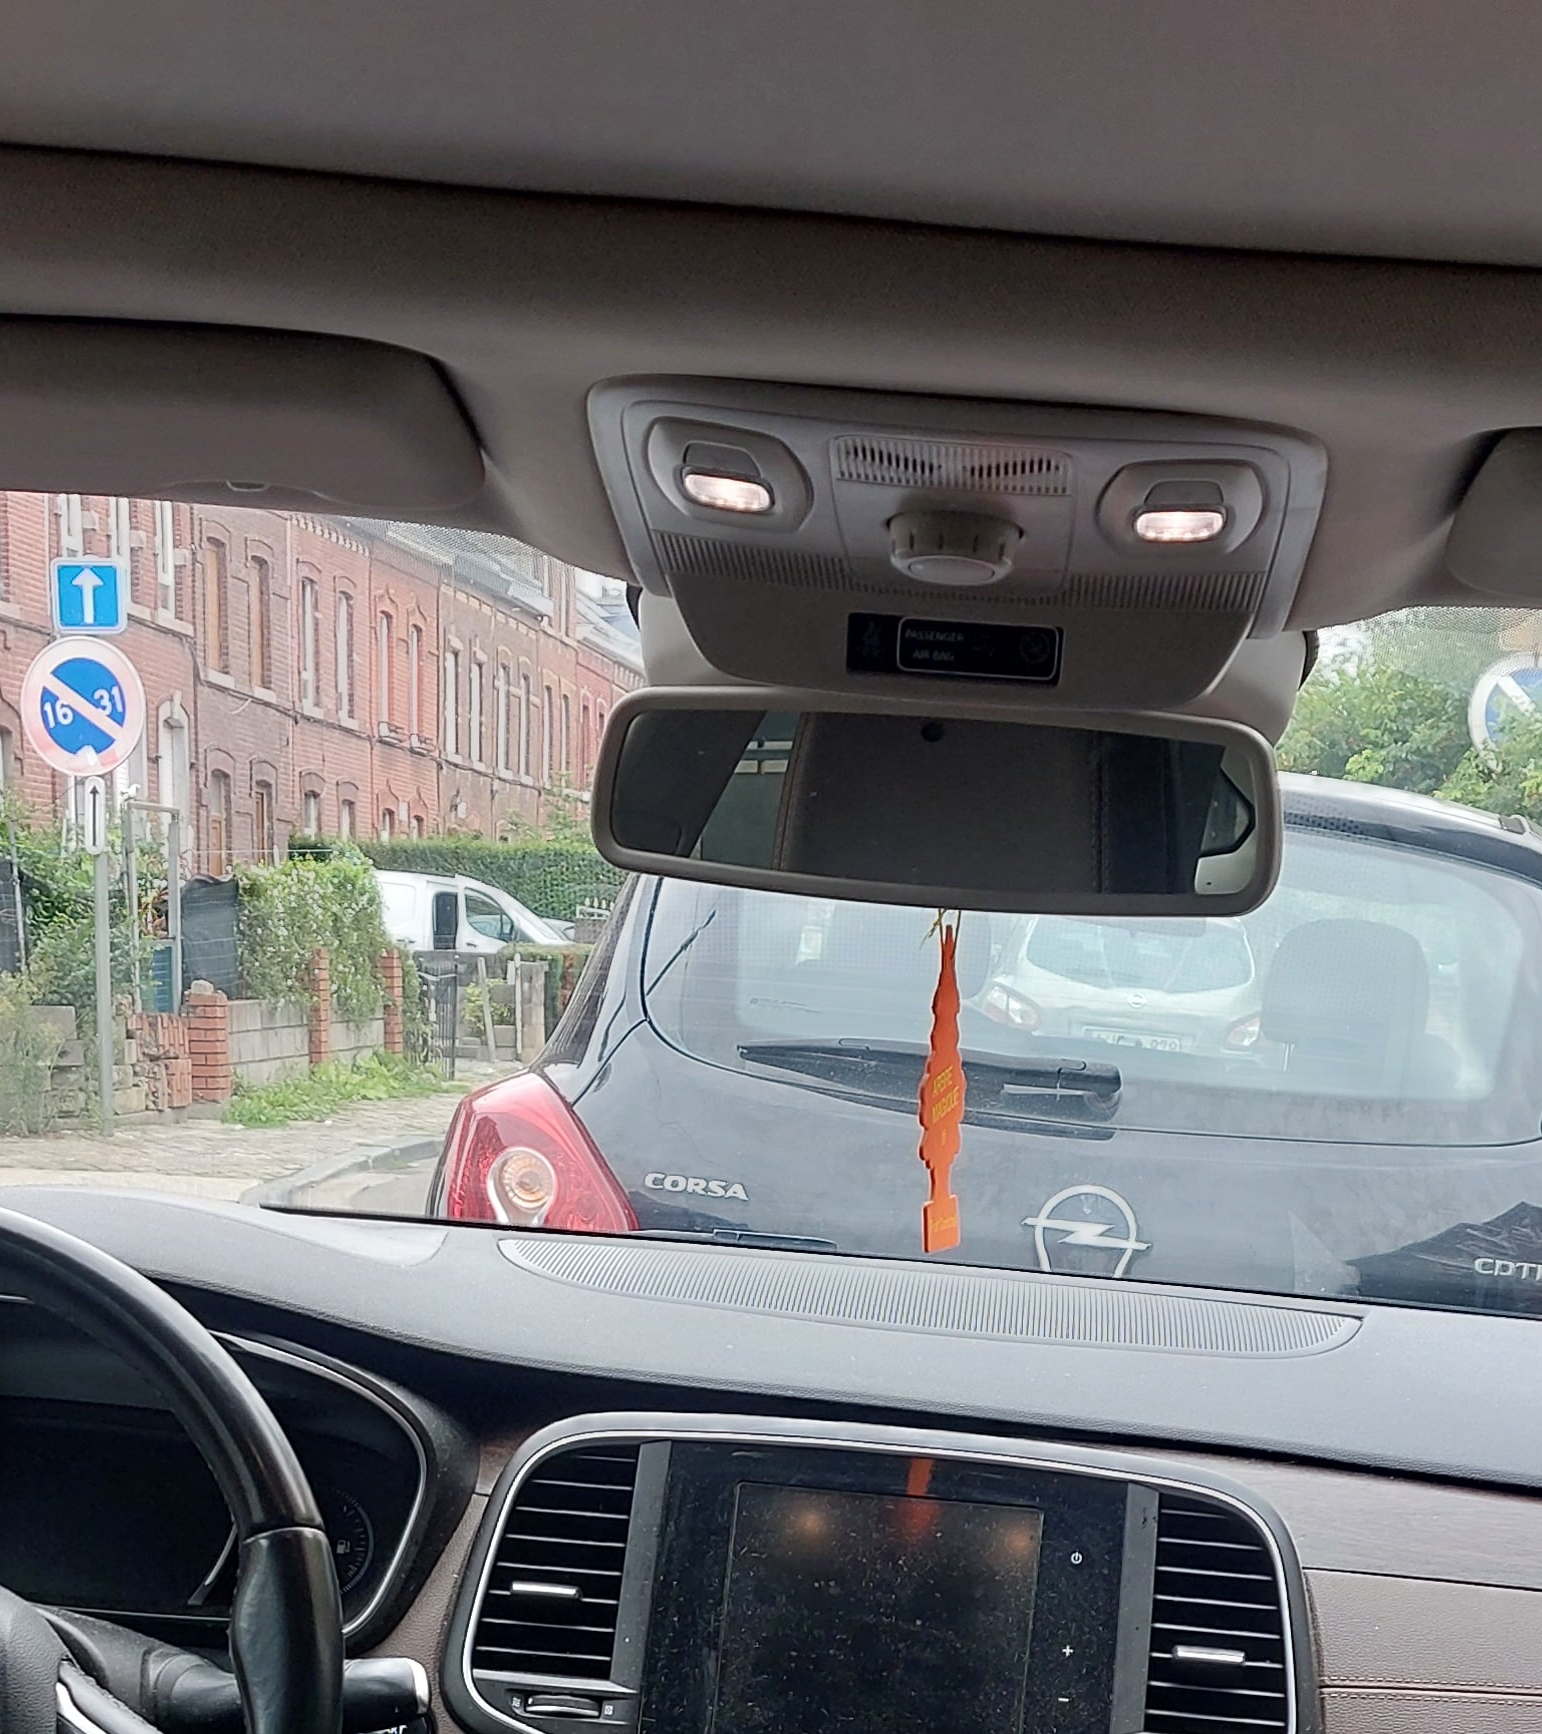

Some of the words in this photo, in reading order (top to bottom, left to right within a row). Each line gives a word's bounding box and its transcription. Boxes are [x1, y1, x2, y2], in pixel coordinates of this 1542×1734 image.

[43, 697, 75, 729] 16
[93, 685, 124, 716] 31
[644, 1172, 750, 1201] CORSA
